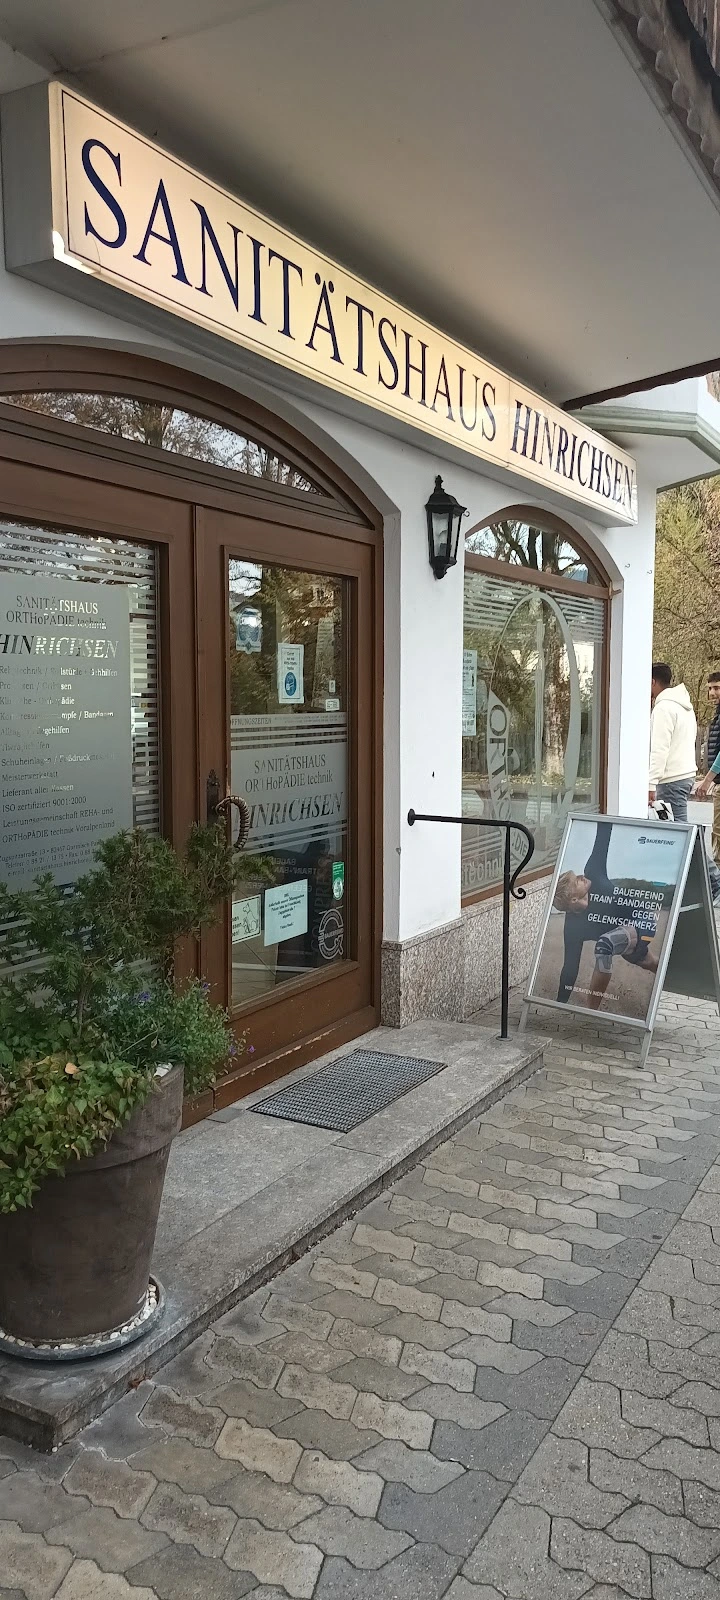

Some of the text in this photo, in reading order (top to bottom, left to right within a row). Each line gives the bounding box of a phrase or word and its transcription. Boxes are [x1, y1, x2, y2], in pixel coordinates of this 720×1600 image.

[81, 138, 635, 512] SANITÄTSHAUS HINRICHSEN
[16, 595, 99, 614] SANITÄTSHAUS
[0, 634, 119, 658] HINRICHSEN
[254, 753, 327, 775] SANITÄTSHAUS
[306, 769, 333, 786] technik
[2, 789, 33, 799] Lieferant
[3, 796, 87, 813] ISO zertifiziert 9001:2000
[80, 808, 100, 818] REHA-
[101, 807, 114, 815] und
[613, 886, 665, 902] BAUERFEIND
[632, 909, 660, 922] GEGEN
